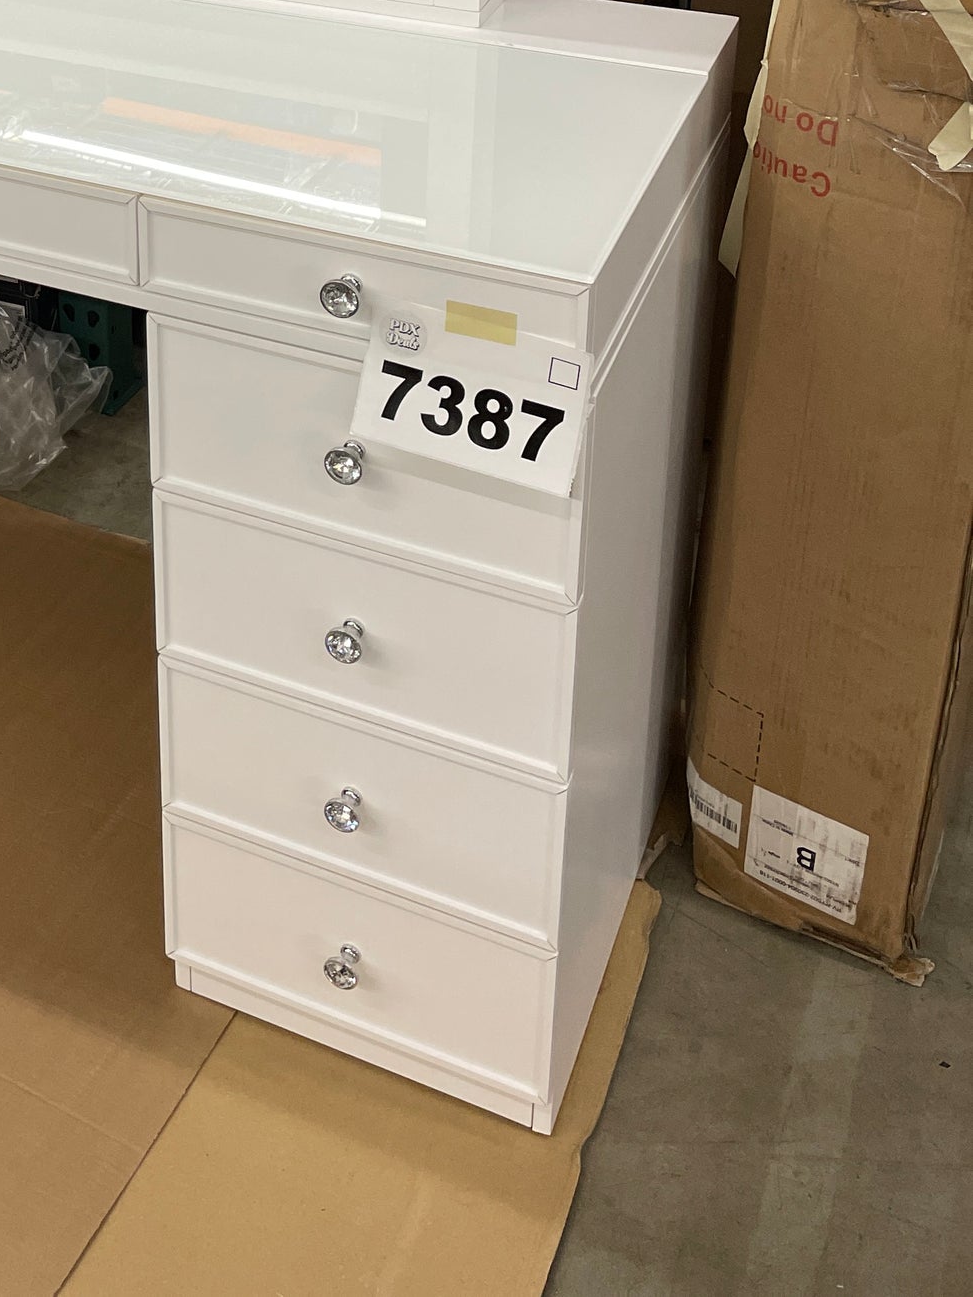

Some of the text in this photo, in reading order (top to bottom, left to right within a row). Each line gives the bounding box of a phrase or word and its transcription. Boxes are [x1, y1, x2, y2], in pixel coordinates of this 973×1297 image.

[796, 111, 839, 147] Do
[389, 318, 421, 337] PDX
[386, 331, 420, 351] Deals
[380, 359, 566, 462] 7387
[796, 847, 816, 871] B
